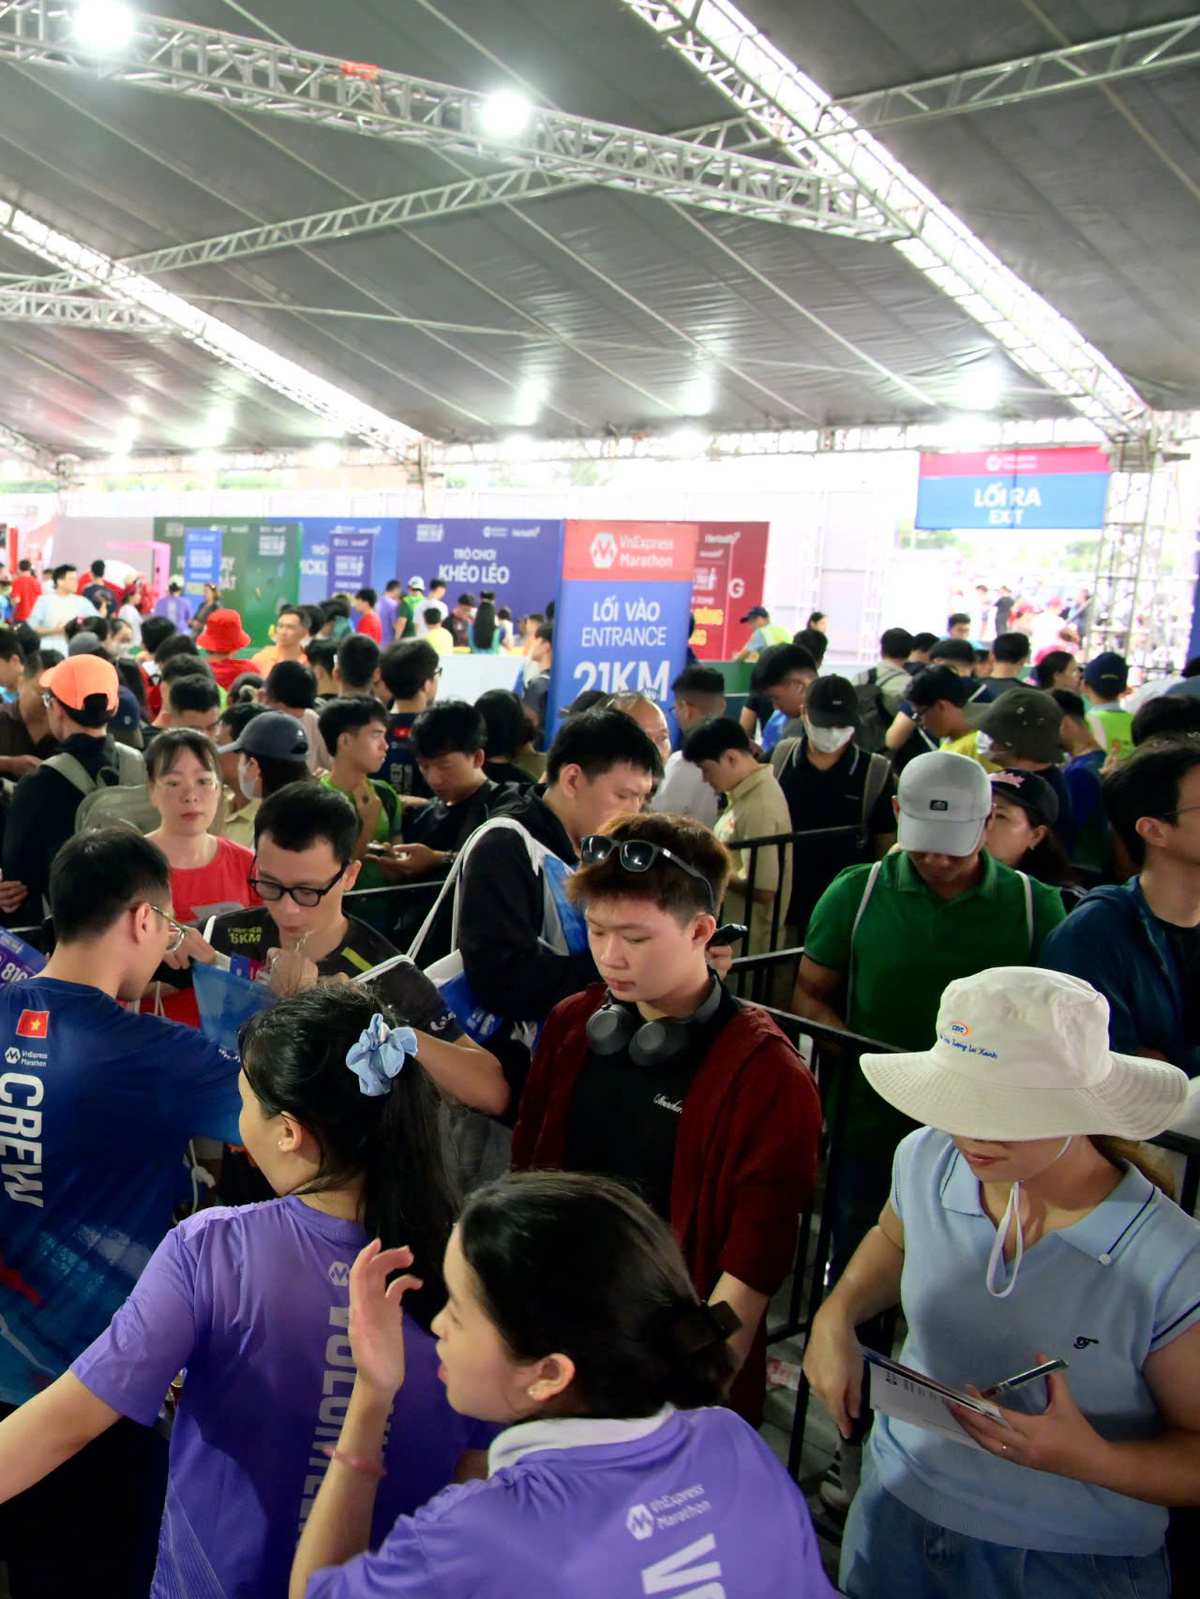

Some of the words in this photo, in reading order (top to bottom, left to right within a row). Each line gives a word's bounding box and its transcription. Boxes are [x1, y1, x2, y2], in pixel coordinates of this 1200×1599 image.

[1010, 487, 1043, 508] RA
[620, 533, 674, 551] VnExpress
[619, 553, 674, 569] Marathon
[439, 562, 480, 583] KHÉO
[482, 562, 510, 585] LÉO
[592, 594, 620, 622] LỐI
[625, 595, 660, 622] VÀO
[581, 626, 668, 648] ENTRANCE
[573, 660, 670, 702] 21KM
[20, 1058, 47, 1068] Marathon
[22, 1050, 48, 1060] VnExpress
